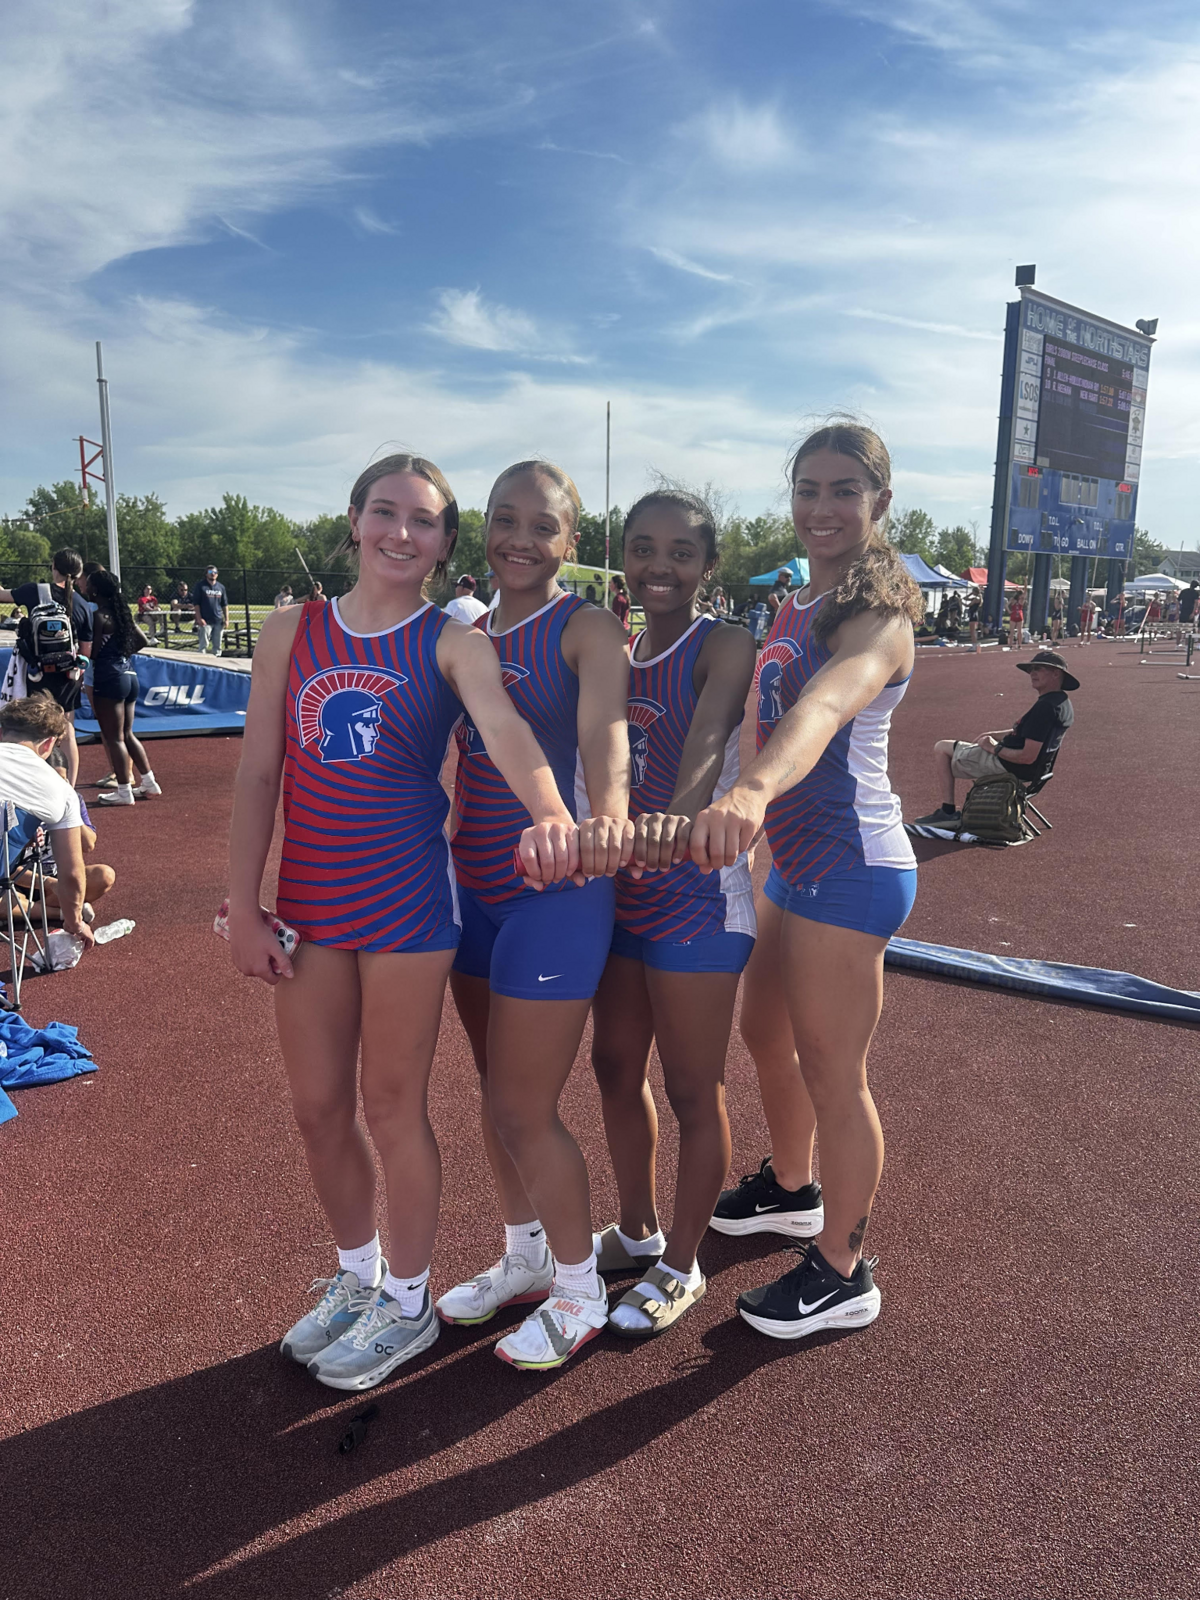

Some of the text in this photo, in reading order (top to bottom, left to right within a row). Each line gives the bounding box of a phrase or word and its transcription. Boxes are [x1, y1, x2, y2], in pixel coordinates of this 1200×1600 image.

[1027, 303, 1063, 337] HOME
[1068, 318, 1077, 330] OF
[1066, 329, 1078, 343] THE
[1080, 323, 1149, 367] NORTHSTARS
[1024, 382, 1039, 402] SOS
[1018, 533, 1033, 544] DOWN
[1061, 537, 1069, 547] GO
[1077, 538, 1096, 549] BALL ON
[144, 685, 205, 705] GILL
[552, 1299, 585, 1317] NIKE
